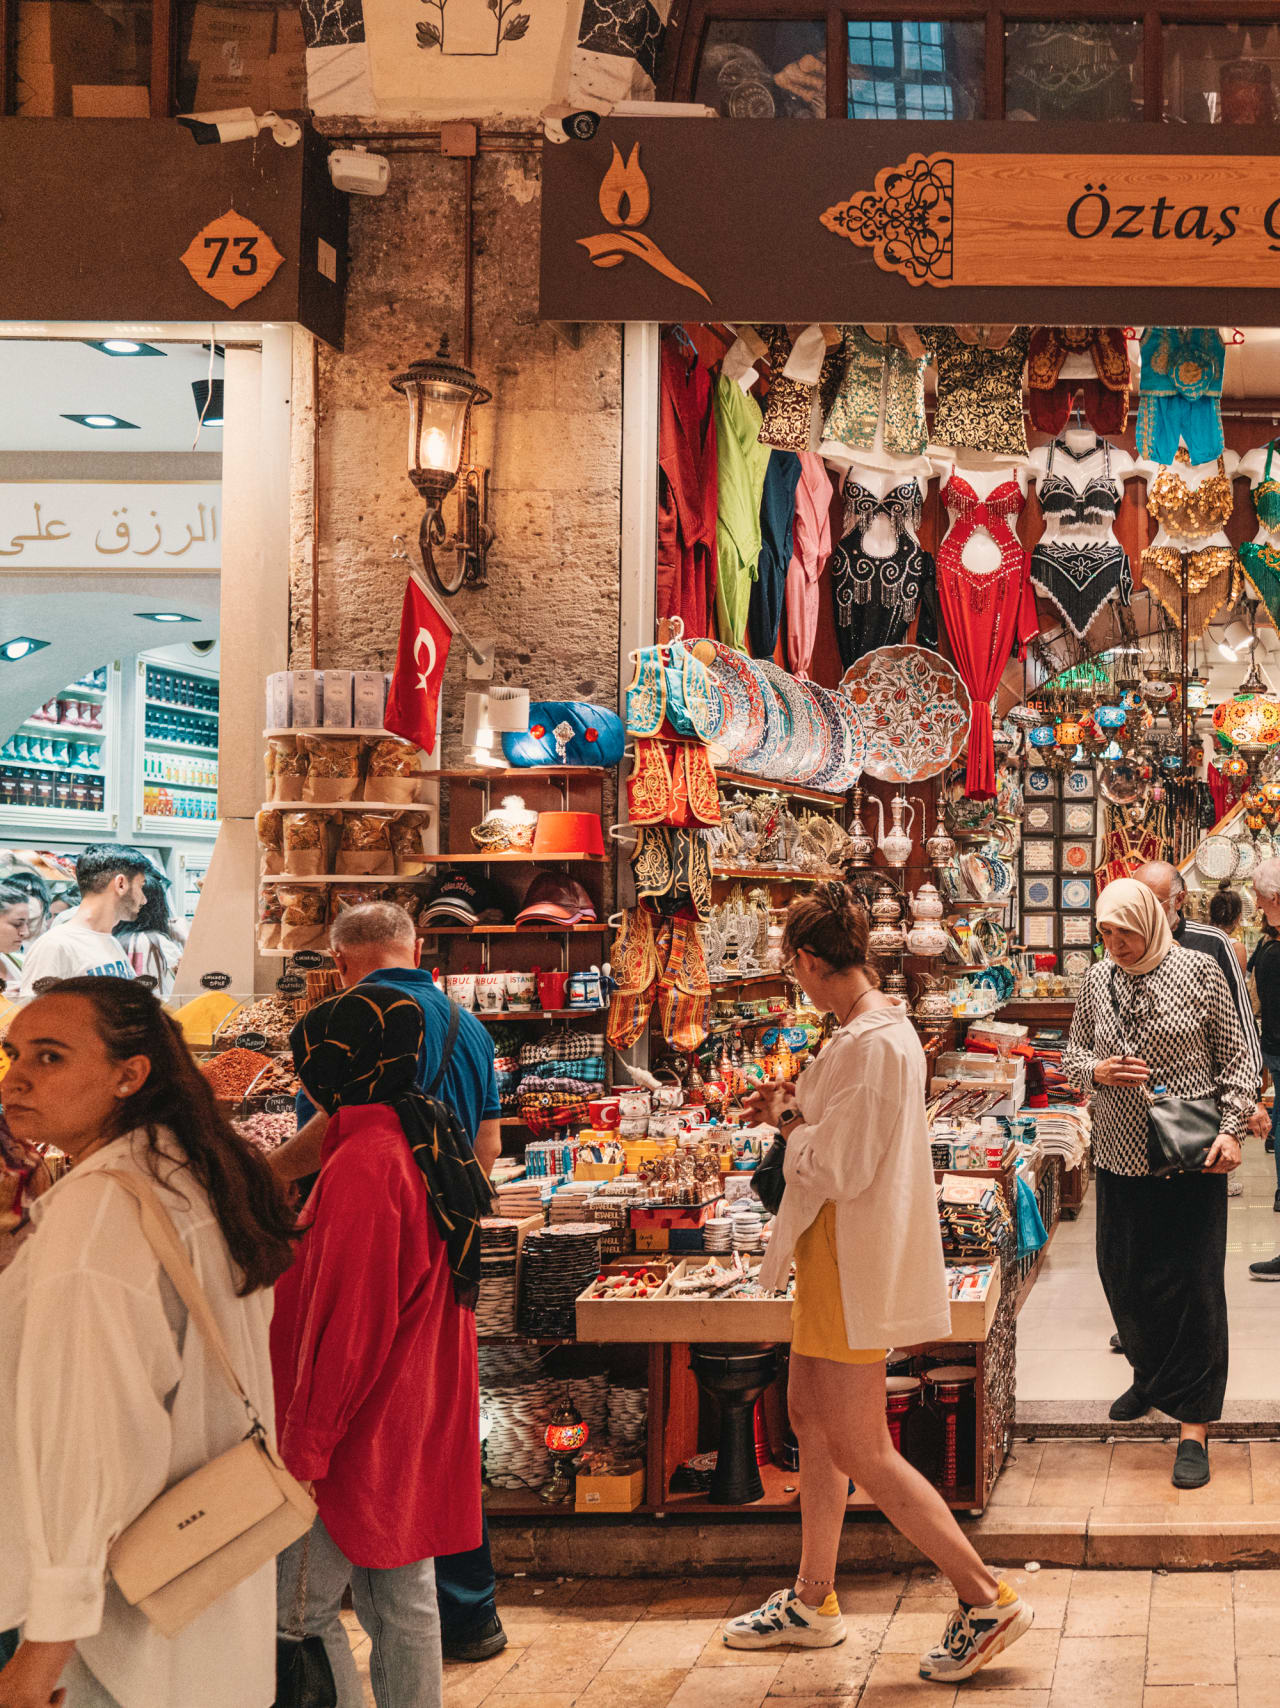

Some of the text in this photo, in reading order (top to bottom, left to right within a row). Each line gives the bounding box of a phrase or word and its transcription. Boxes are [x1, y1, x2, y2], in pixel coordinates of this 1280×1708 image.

[1066, 183, 1240, 246] Öztaş
[203, 236, 258, 279] 73
[95, 502, 217, 556] الرزق
[177, 1509, 206, 1531] ZARA
